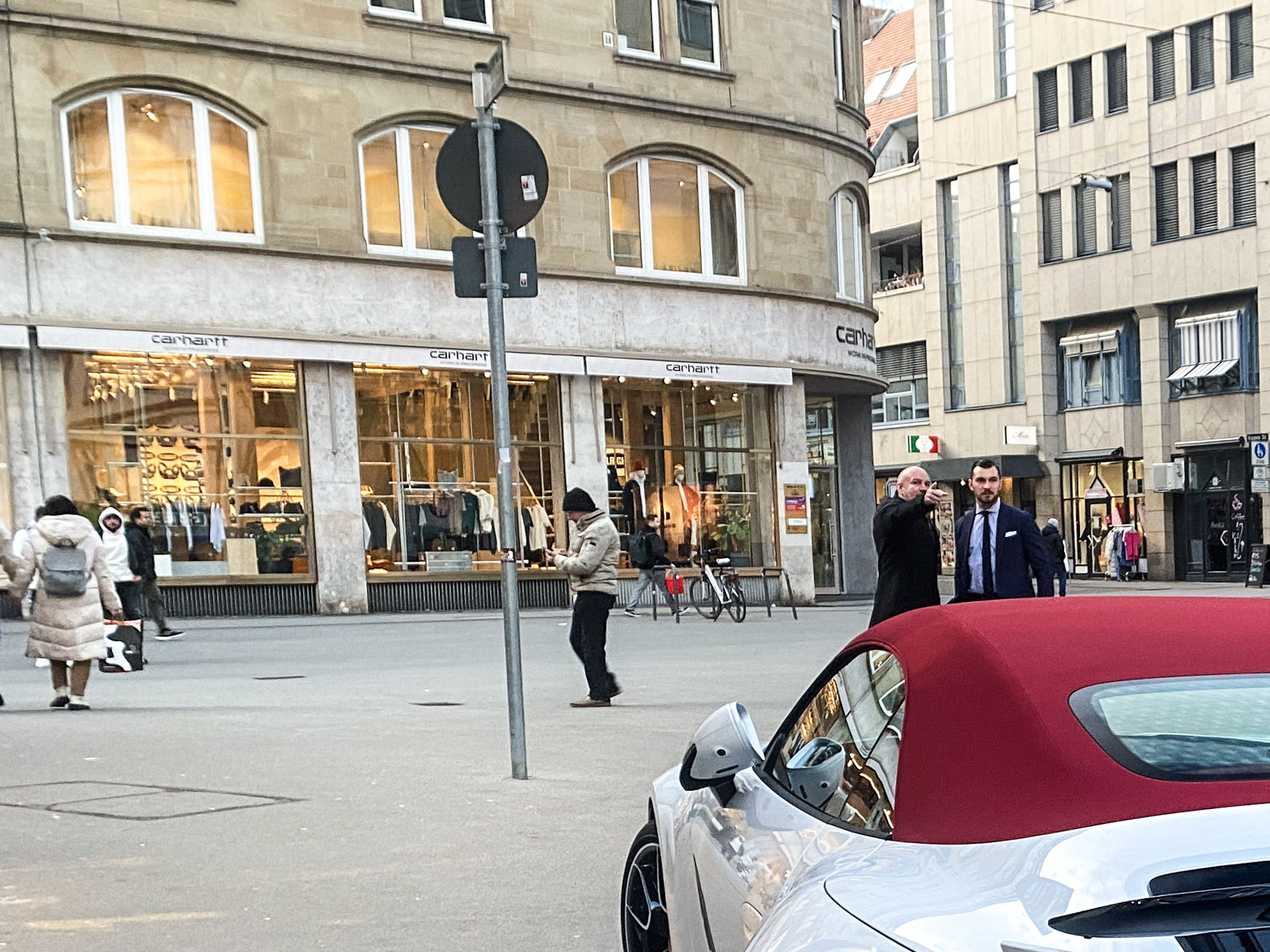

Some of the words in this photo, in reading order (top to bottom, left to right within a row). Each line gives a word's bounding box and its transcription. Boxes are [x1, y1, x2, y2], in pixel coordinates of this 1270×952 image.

[151, 334, 229, 347] carhartt
[429, 350, 489, 361] carhart
[665, 363, 720, 374] carhartt
